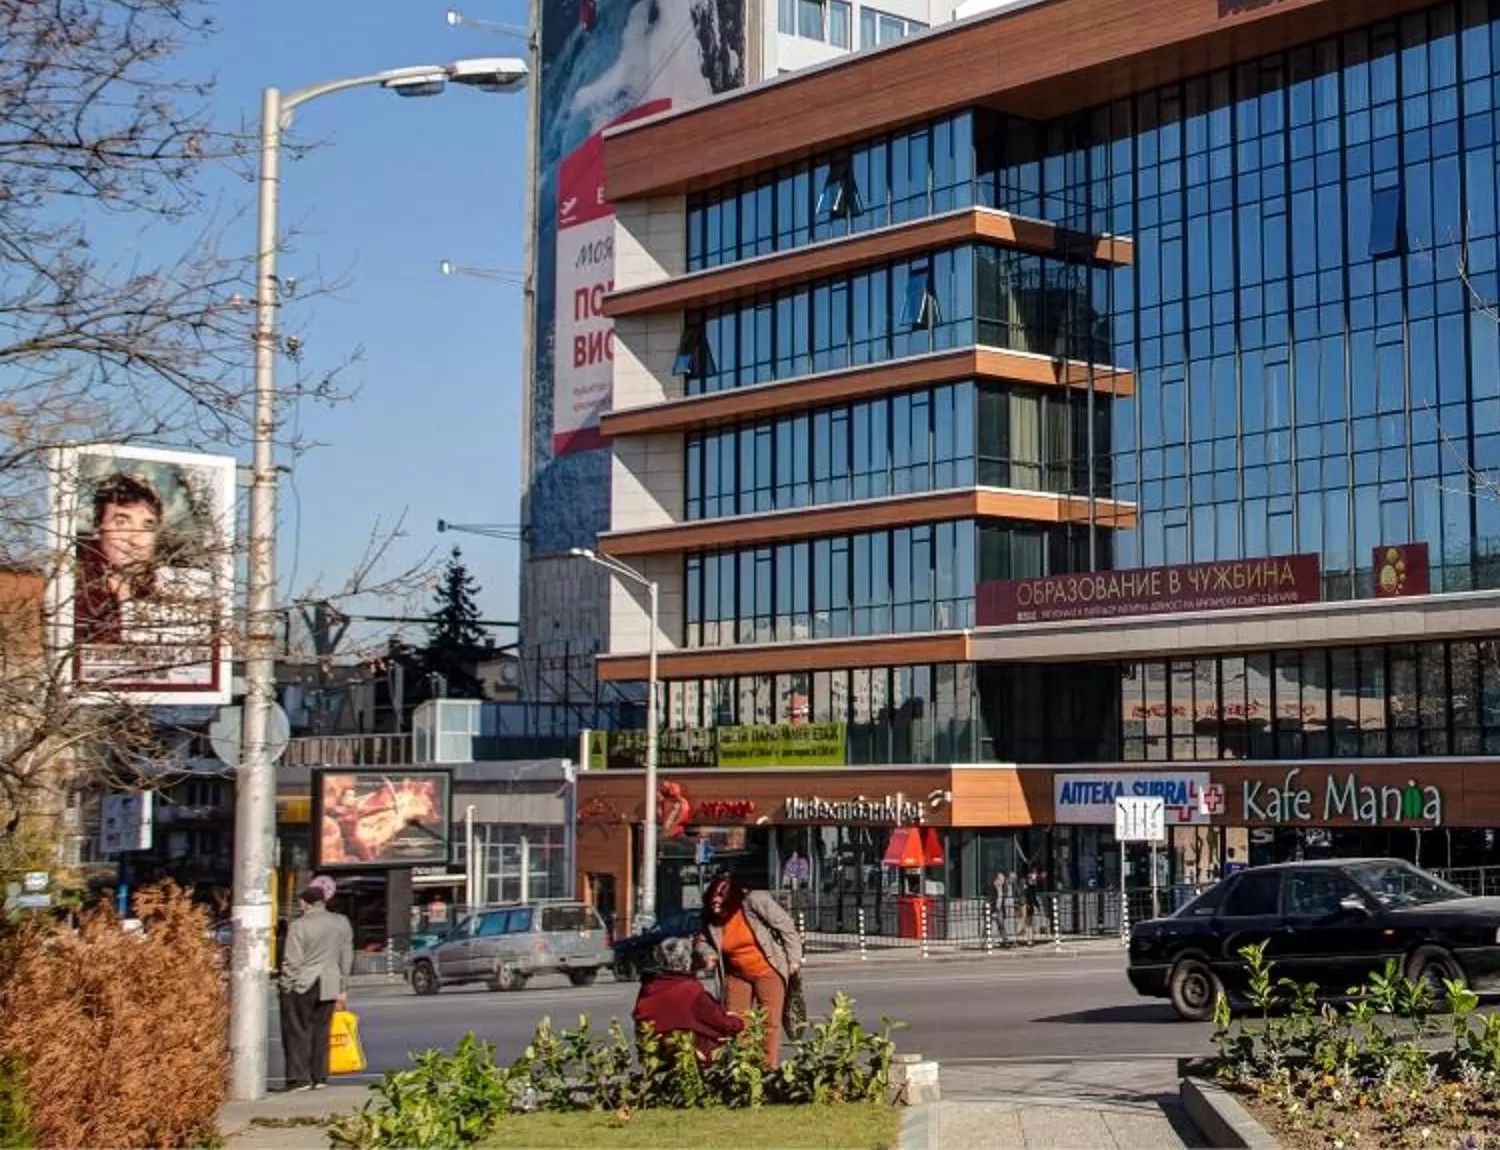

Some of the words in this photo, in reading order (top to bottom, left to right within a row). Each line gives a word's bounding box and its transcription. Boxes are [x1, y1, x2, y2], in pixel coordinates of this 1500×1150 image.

[1016, 571, 1161, 606] ОБРАЗОВАНИЕ
[1169, 569, 1181, 595] В
[1187, 561, 1295, 592] ЧУЖБИНА
[1060, 781, 1126, 805] АПТЕКА
[1243, 768, 1311, 823] Kafe
[1323, 773, 1441, 827] Mania
